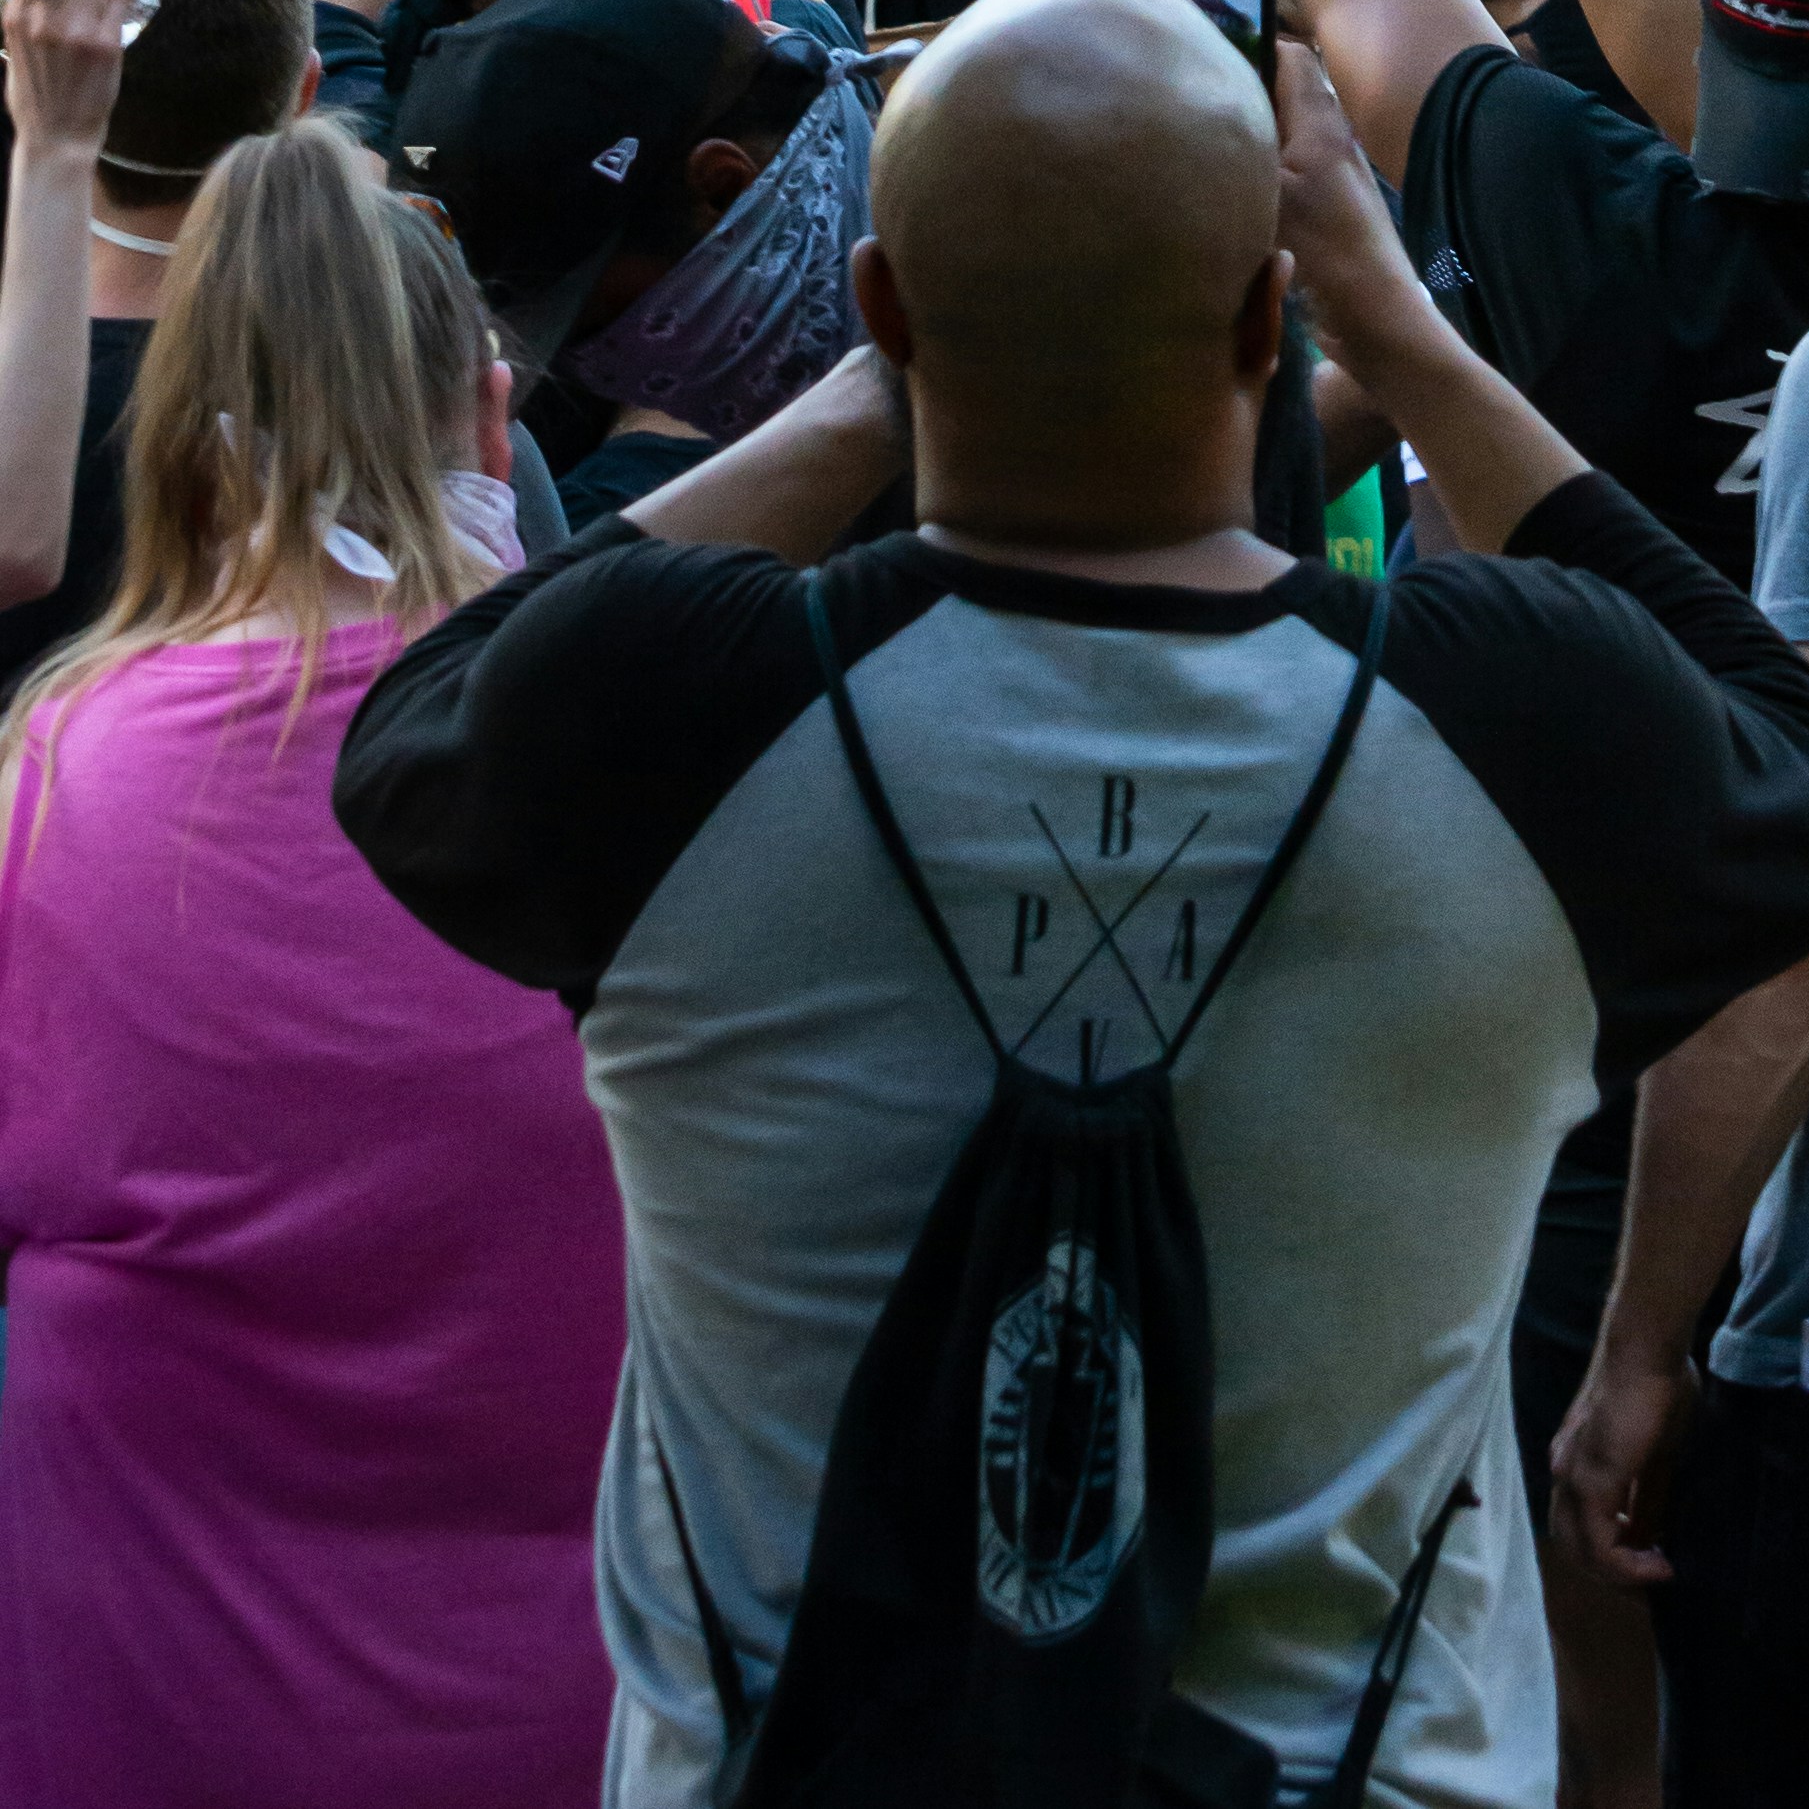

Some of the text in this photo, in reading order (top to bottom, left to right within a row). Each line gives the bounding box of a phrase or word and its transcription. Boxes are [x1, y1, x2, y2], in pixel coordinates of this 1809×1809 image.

[1096, 775, 1137, 859] B
[1012, 893, 1197, 982] P A
